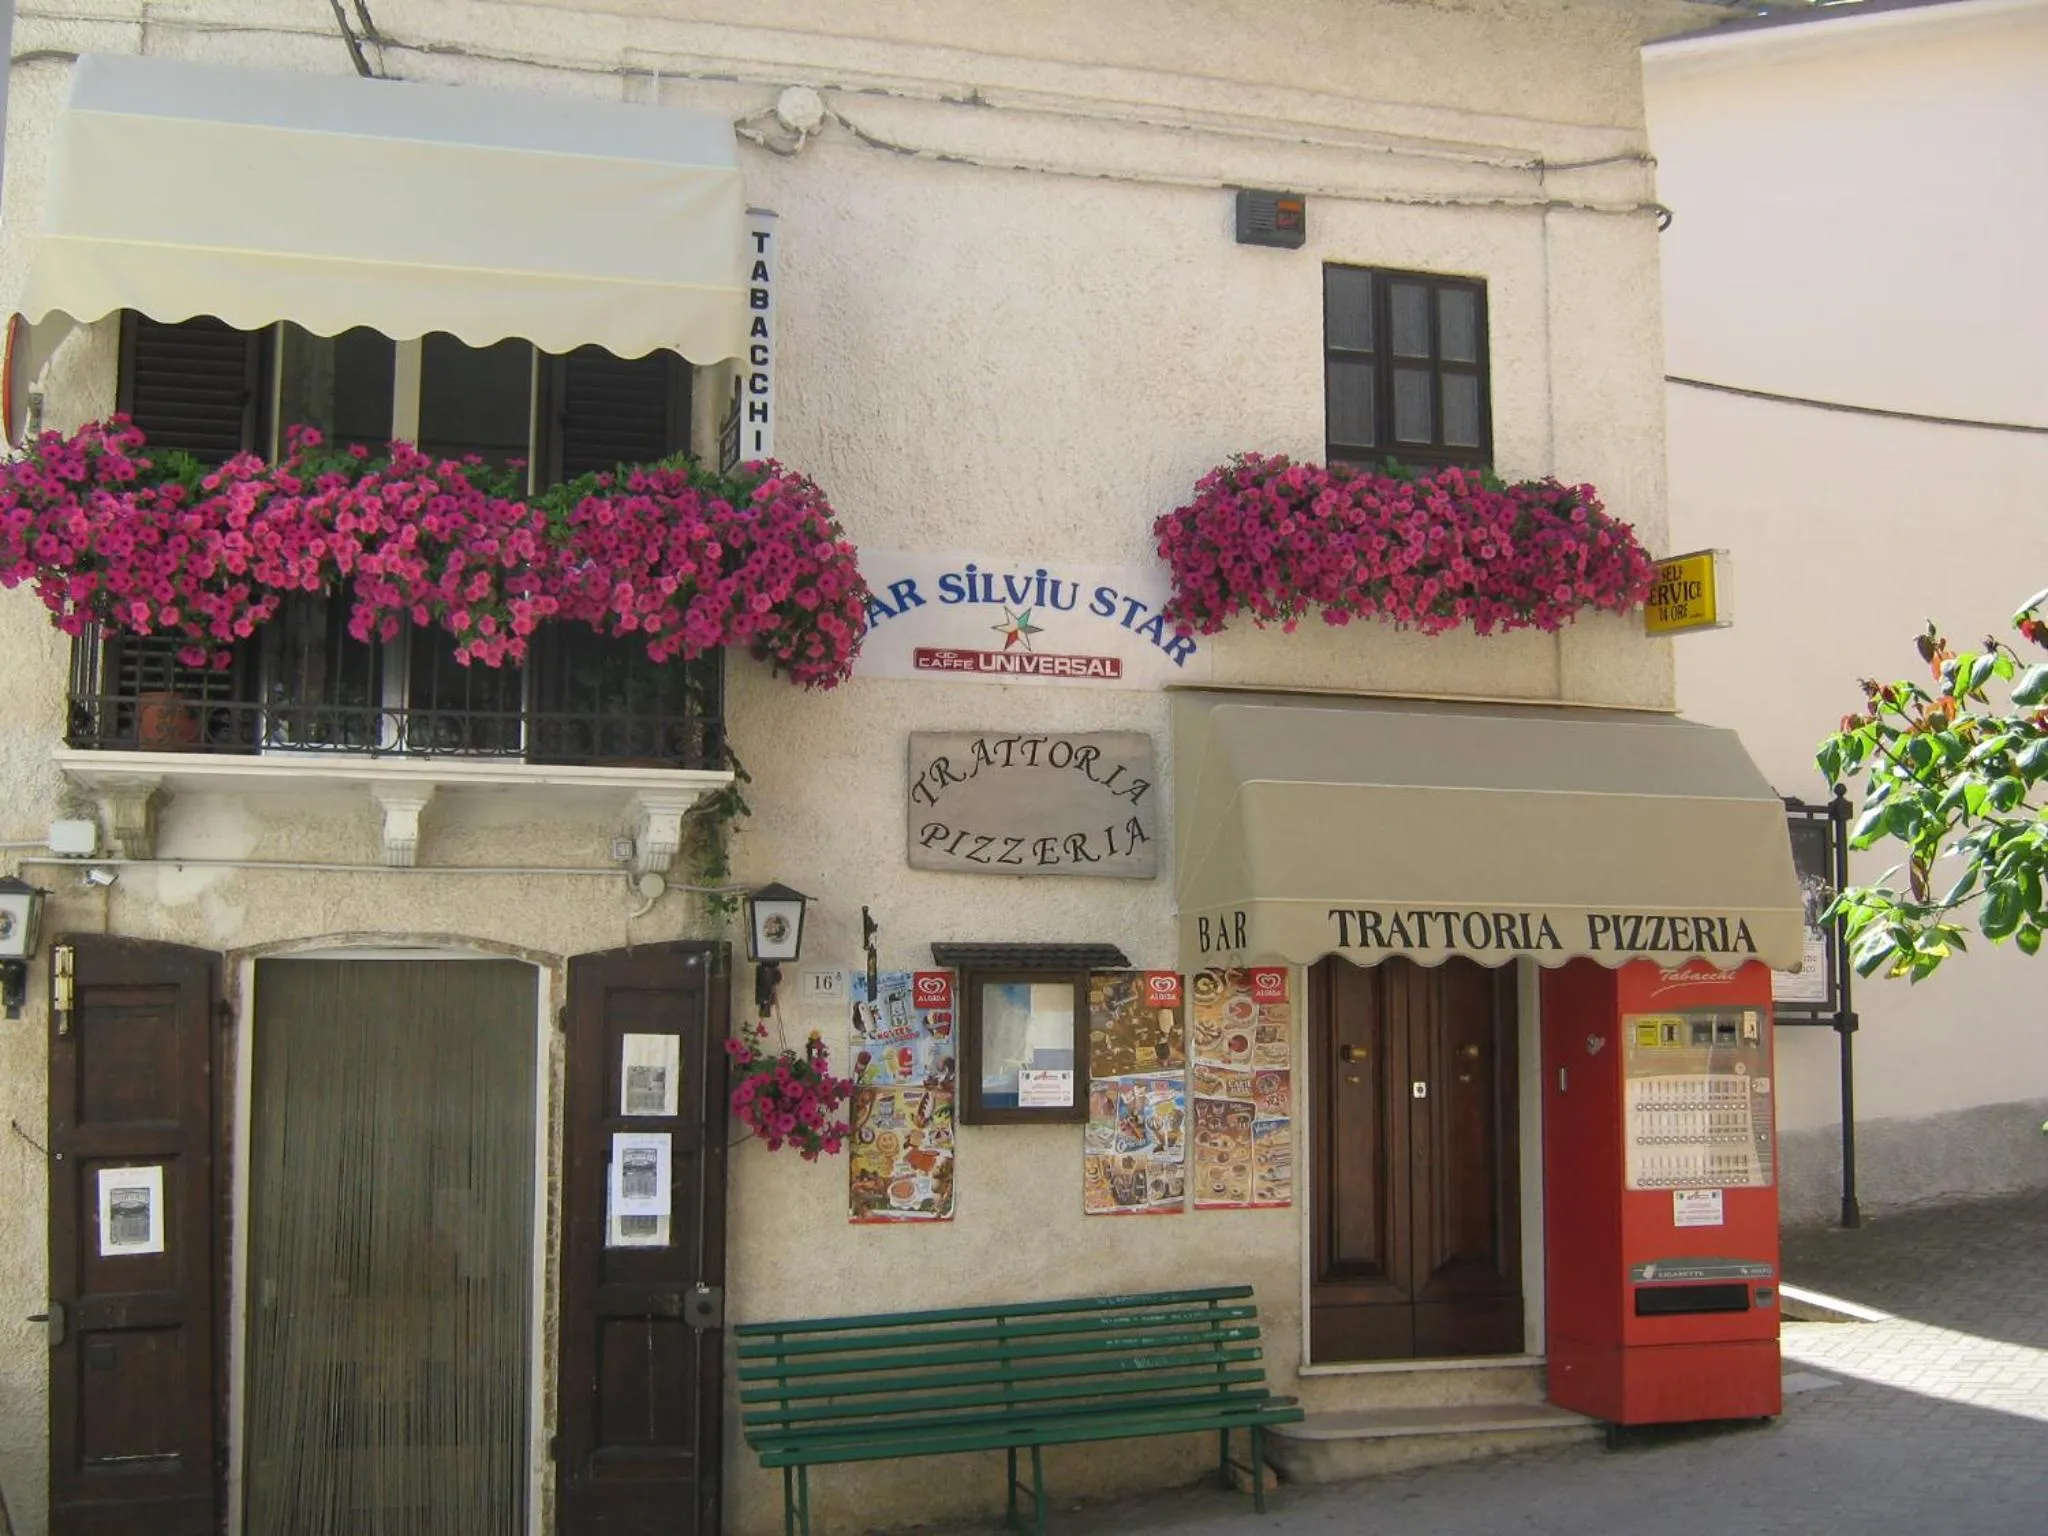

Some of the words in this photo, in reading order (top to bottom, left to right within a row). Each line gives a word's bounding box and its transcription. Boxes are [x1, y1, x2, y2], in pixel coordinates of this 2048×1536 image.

[749, 231, 770, 452] TABACCHI
[1648, 581, 1703, 606] ERVICE
[861, 579, 926, 637] AR
[1089, 587, 1197, 668] STAR
[979, 653, 1119, 677] UNIVERSAL
[912, 736, 1151, 807] TRATTORIA
[919, 816, 1150, 866] PIZZERIA
[1198, 911, 1246, 953] BAR
[1328, 909, 1563, 950] TRATTORIA
[1587, 914, 1758, 953] PIZZERIA
[816, 975, 833, 990] 16
